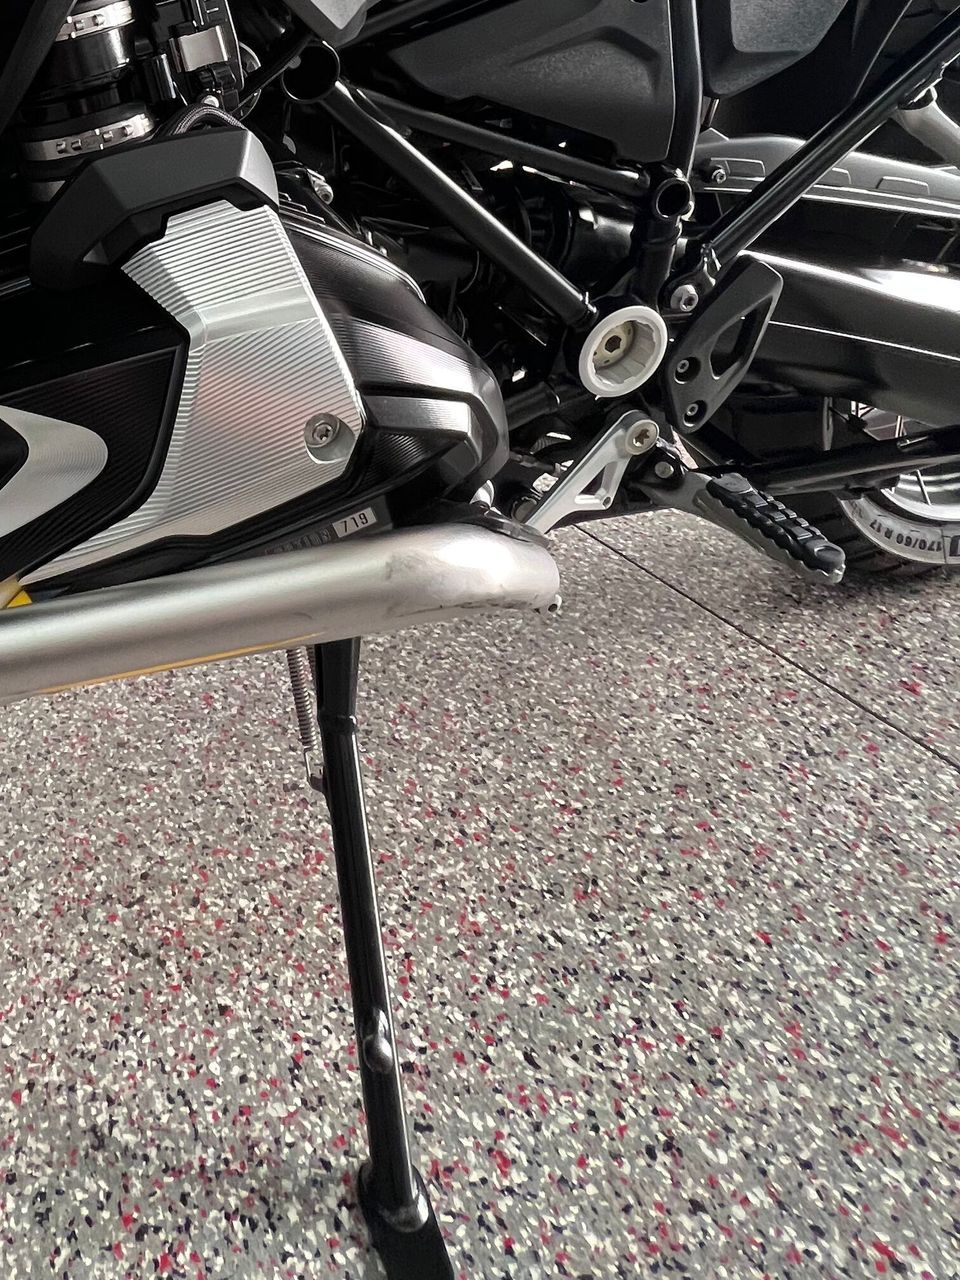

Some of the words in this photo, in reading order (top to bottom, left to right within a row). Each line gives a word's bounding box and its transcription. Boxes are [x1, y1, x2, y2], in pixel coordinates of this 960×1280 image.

[340, 512, 370, 533] 719
[869, 519, 884, 533] 17
[884, 529, 894, 540] R
[895, 533, 943, 552] 170/60
